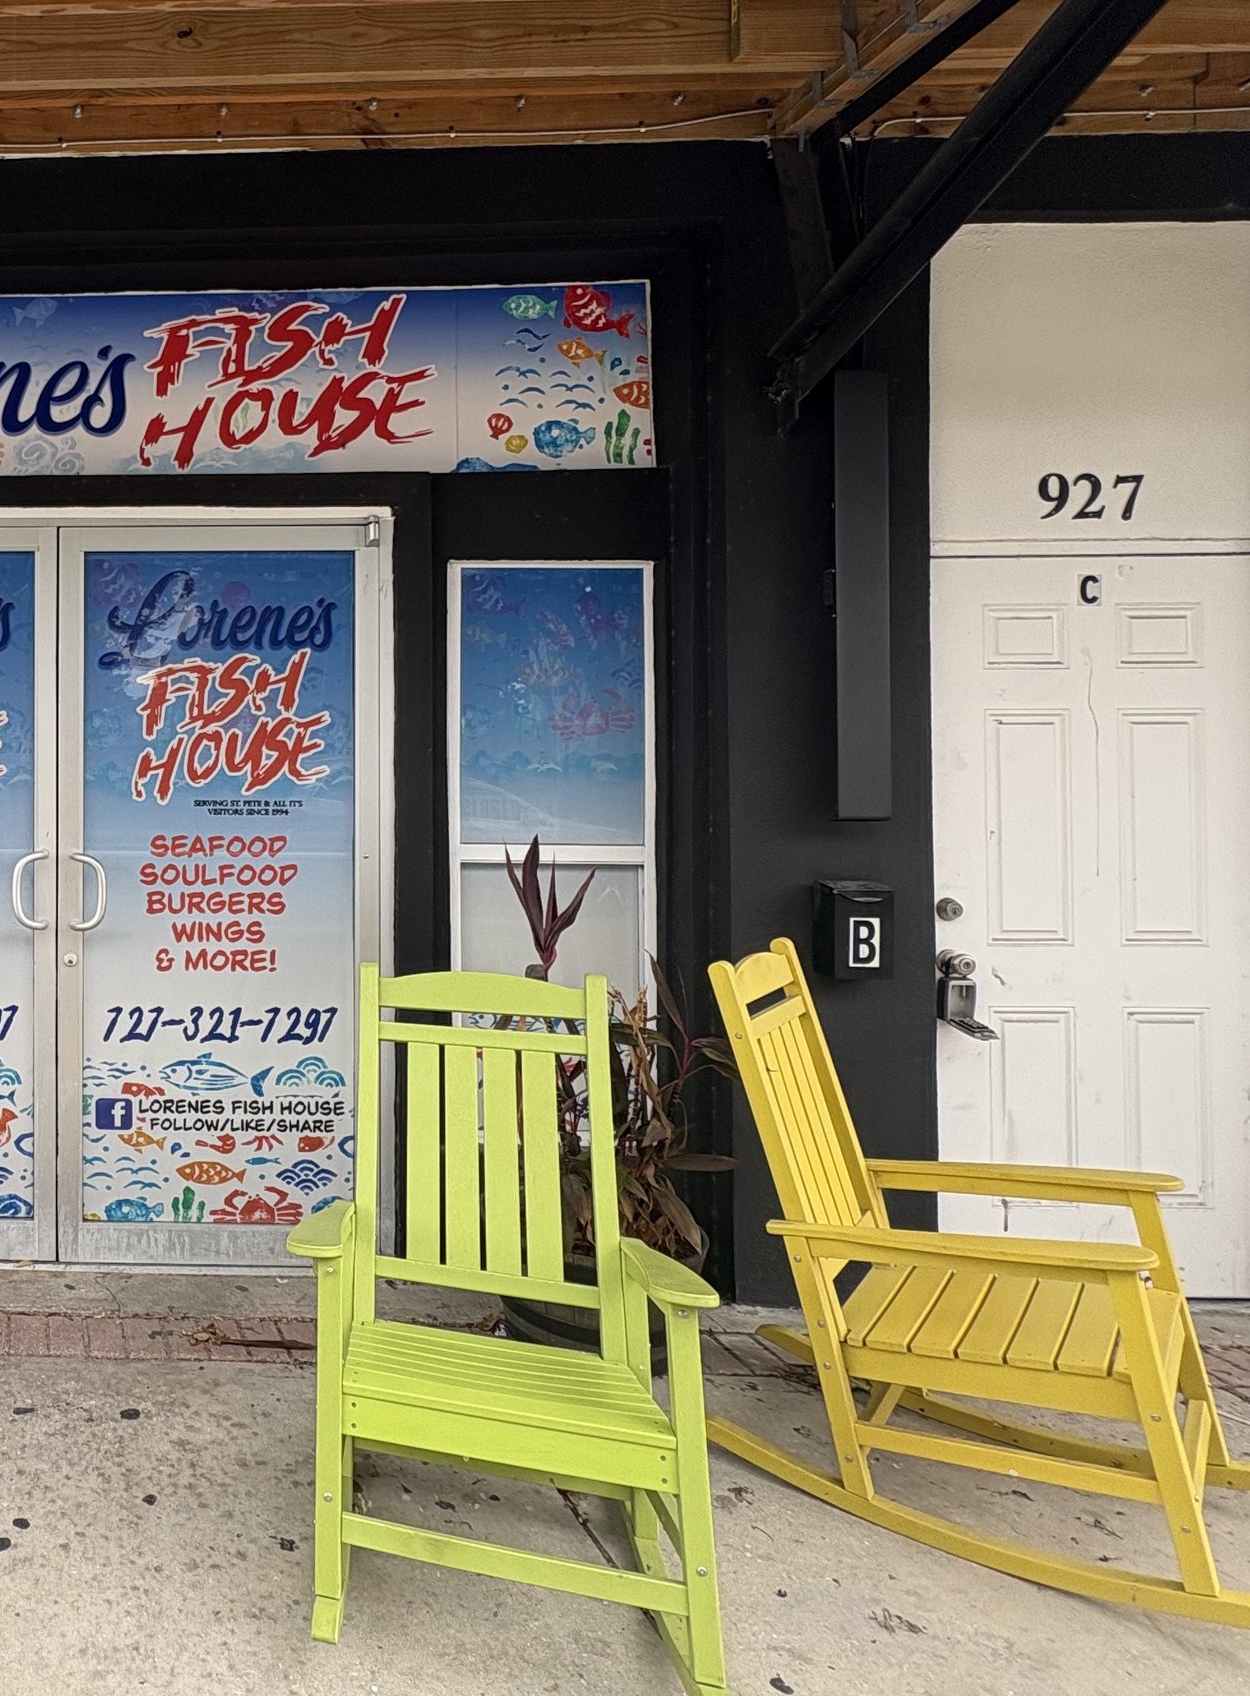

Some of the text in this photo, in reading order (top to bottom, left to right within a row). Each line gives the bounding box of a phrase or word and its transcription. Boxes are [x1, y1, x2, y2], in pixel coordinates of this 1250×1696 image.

[144, 293, 406, 398] FISH
[140, 365, 436, 471] HOUSE
[1037, 472, 1145, 522] 927
[1079, 575, 1100, 604] C
[97, 570, 338, 671] Lorene's
[136, 648, 311, 739] FISH
[132, 710, 331, 805] HOUSE
[193, 799, 229, 807] SERVING
[243, 800, 262, 808] PETE
[263, 800, 271, 808] &
[272, 800, 287, 808] ALL
[207, 808, 289, 816] VISITORS SINCE 1994
[149, 834, 288, 859] SEAFOOD
[139, 863, 299, 886] SOULFOOD
[145, 891, 287, 915] BURGERS
[171, 920, 266, 944] WINGS
[852, 919, 876, 965] B
[155, 948, 278, 973] & MORE!
[103, 1005, 338, 1045] 727-321-7297
[138, 1098, 225, 1115] LORENES
[231, 1099, 274, 1115] FISH
[280, 1100, 346, 1116] HOUSE
[149, 1117, 336, 1133] FOLLOW/LIKE/SHARE
